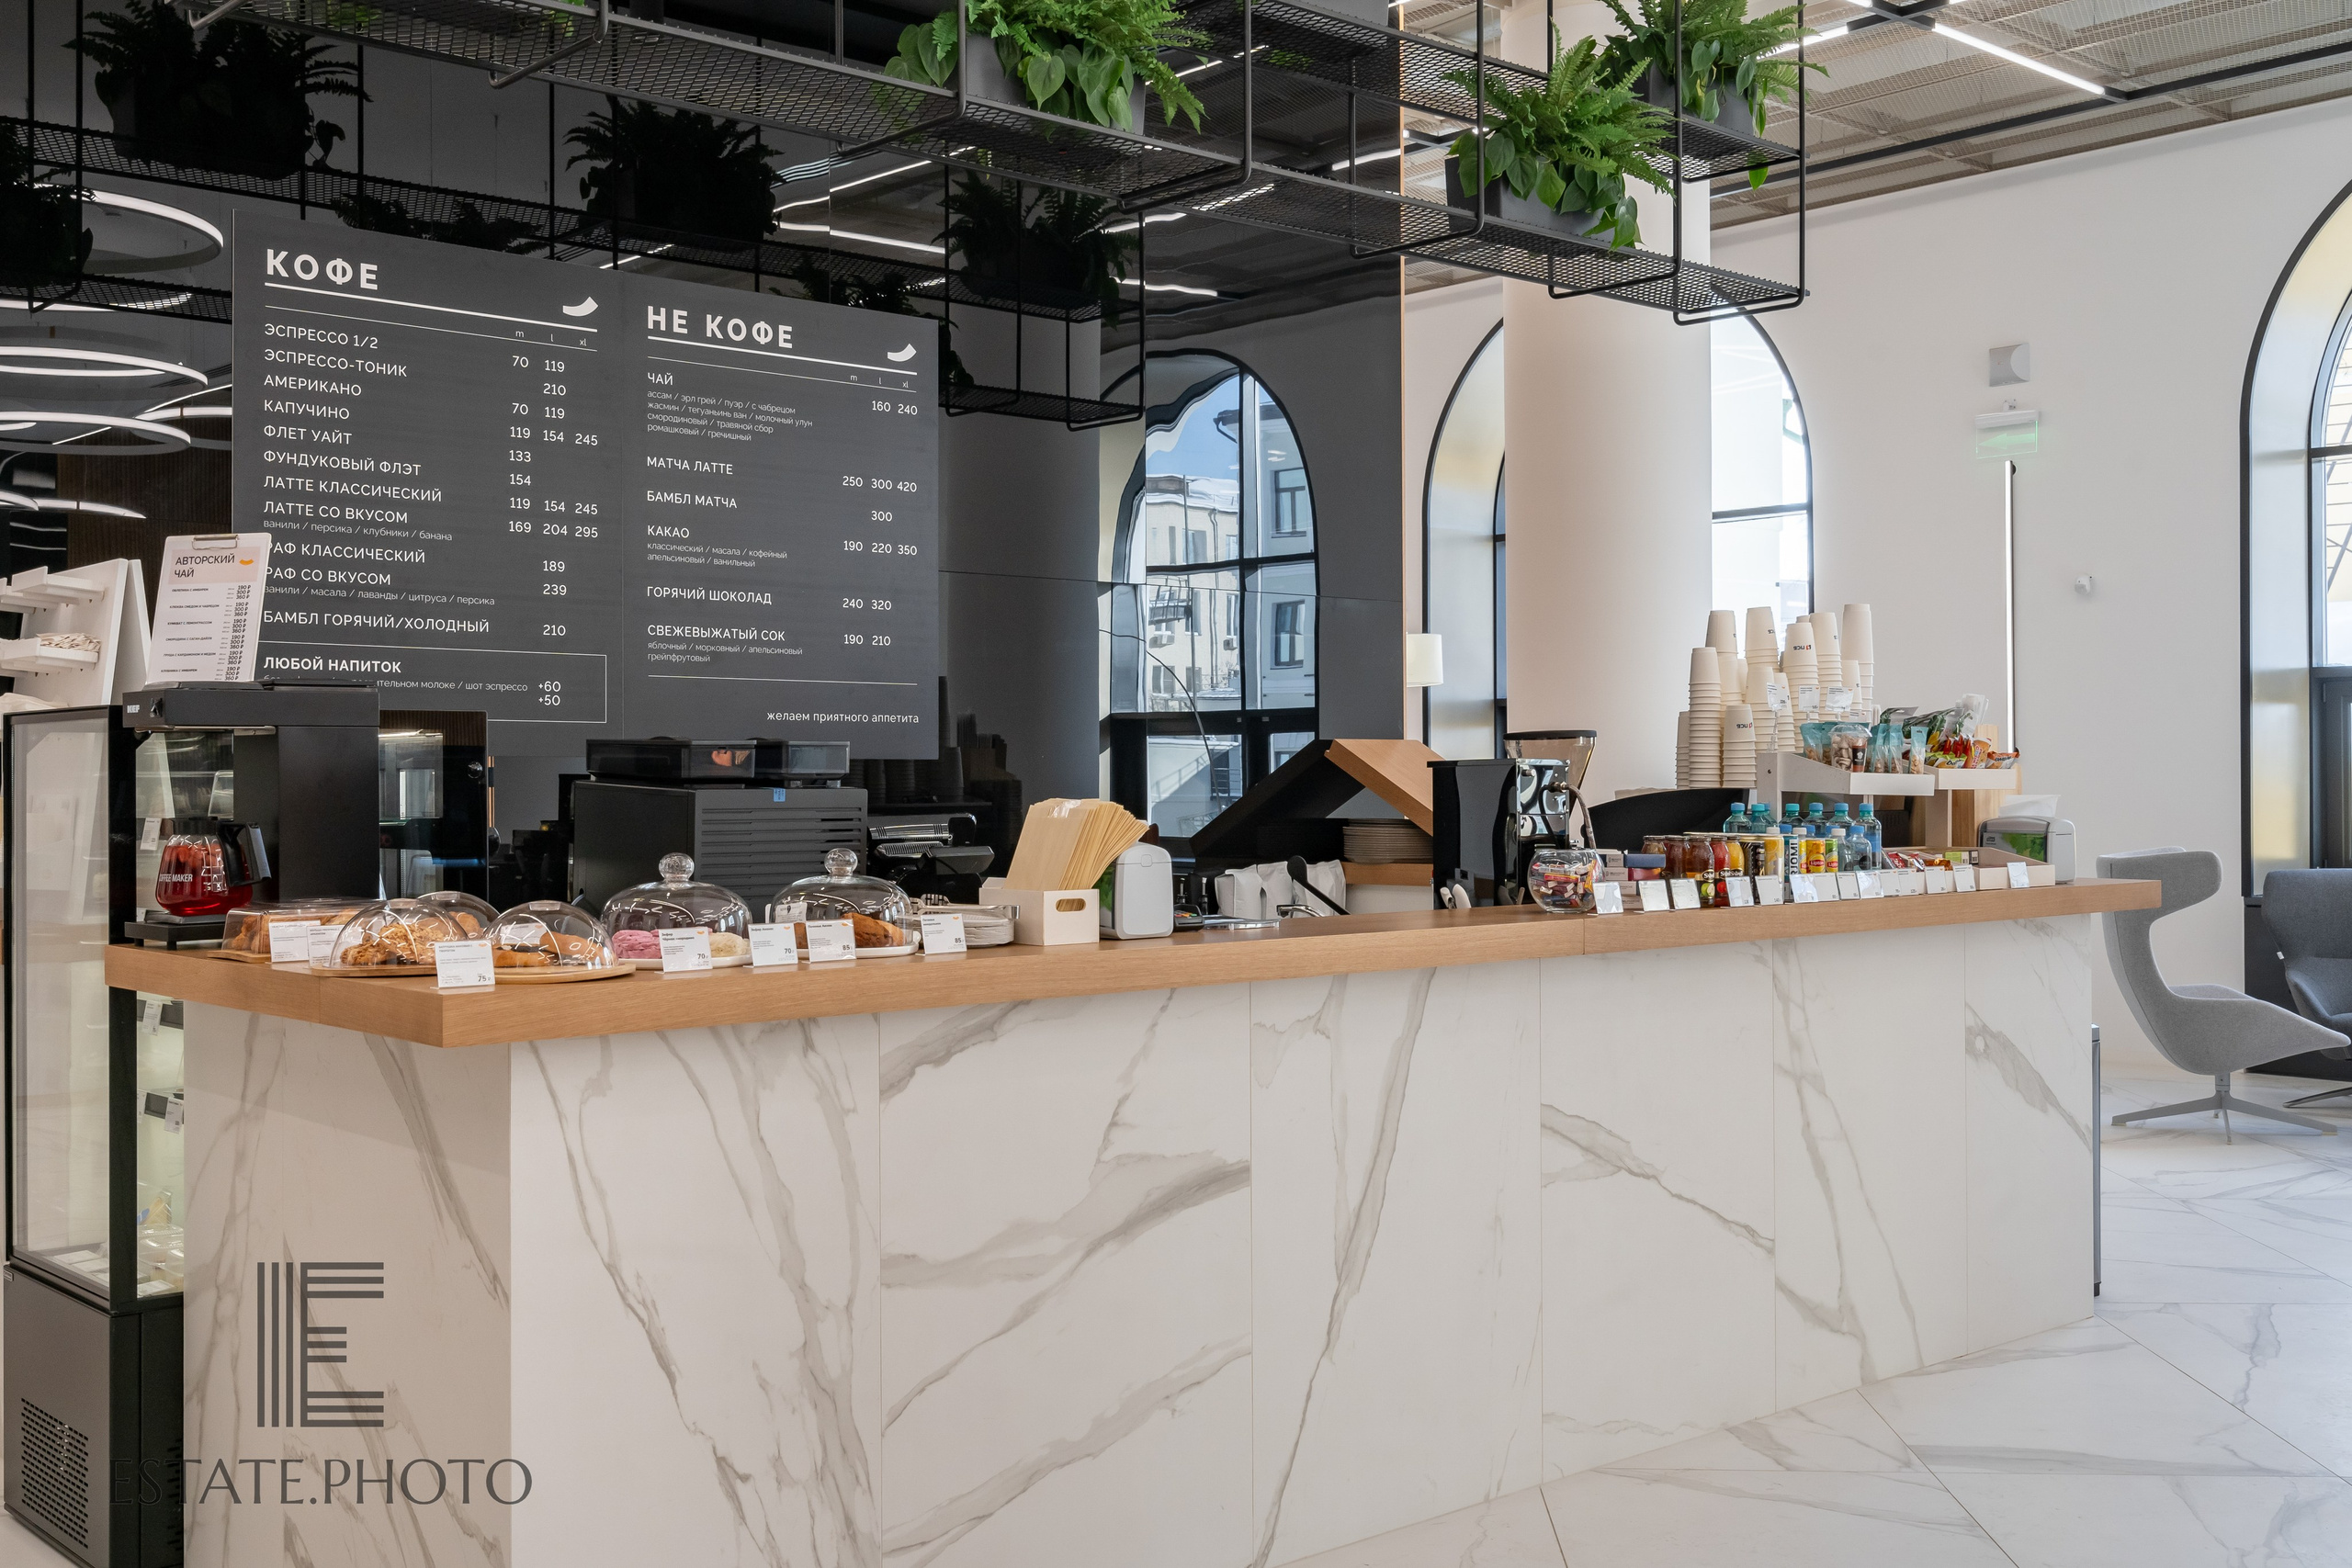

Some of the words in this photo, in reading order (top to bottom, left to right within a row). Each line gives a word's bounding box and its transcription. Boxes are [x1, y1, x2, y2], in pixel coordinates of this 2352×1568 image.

[267, 249, 378, 290] КОФЕ
[648, 306, 687, 333] НЕ
[707, 314, 792, 348] КОФЕ
[265, 323, 348, 344] ЭСПРЕССО
[354, 335, 378, 349] 1/2
[265, 349, 407, 377] ЭСПРЕССО-ТОНИК
[513, 355, 528, 367] 70
[545, 360, 564, 372] 119
[264, 375, 361, 396] АМЕРИКАНО
[648, 372, 673, 385] ЧАЙ
[544, 383, 566, 396] 210
[265, 400, 349, 419] КАПУЧИНО
[513, 403, 528, 414] 70
[545, 407, 564, 419] 119
[681, 395, 695, 403] эрл
[697, 397, 716, 405] грей
[725, 400, 743, 409] пуэр
[758, 404, 795, 413] чабрецом
[872, 400, 890, 412] 160
[898, 404, 918, 415] 240
[648, 402, 679, 411] жасмин
[755, 415, 793, 424] молочный
[795, 420, 812, 428] улун
[648, 413, 707, 425] смородиновый
[717, 421, 752, 430] травяной
[754, 424, 774, 434] сбор
[264, 425, 307, 440] ФЛЕТ
[311, 430, 352, 445] УАЙТ
[510, 426, 530, 438] 119
[543, 430, 564, 442] 154
[575, 434, 597, 446] 245
[648, 424, 698, 435] ромашковый
[708, 431, 751, 441] гречишный
[264, 450, 374, 471] ФУНДУКОВЫЙ
[379, 461, 421, 475] ФЛЭТ
[509, 450, 531, 462] 133
[648, 457, 690, 470] МАТЧА
[694, 461, 733, 474] ЛАТТЕ
[510, 474, 531, 486] 154
[842, 476, 863, 487] 250
[872, 479, 892, 490] 300
[897, 481, 917, 492] 420
[264, 476, 313, 491] ЛАТТЕ
[320, 480, 441, 502] КЛАССИЧЕСКИЙ
[510, 497, 530, 509] 119
[545, 501, 565, 512] 154
[575, 503, 597, 514] 245
[648, 491, 690, 504] БАМБЛ
[695, 495, 737, 508] МАТЧА
[264, 502, 313, 516] ЛАТТЕ
[319, 506, 340, 518] СО
[345, 508, 407, 523] ВКУСОМ
[871, 511, 892, 522] 300
[264, 521, 300, 529] ванили
[311, 525, 352, 534] персика
[364, 527, 408, 537] клубники
[420, 530, 452, 540] банана
[509, 521, 531, 533] 169
[543, 524, 568, 536] 204
[575, 526, 598, 537] 295
[648, 525, 689, 538] КАКАО
[269, 542, 297, 556] АФ
[302, 544, 424, 563] КЛАССИЧЕСКИЙ
[648, 544, 703, 552] классический
[749, 549, 786, 558] кофейный
[843, 540, 863, 551] 190
[872, 543, 892, 553] 220
[898, 545, 917, 555] 350
[175, 553, 235, 565] АВТОРСКИЙ
[543, 560, 565, 572] 189
[648, 554, 705, 563] апельсиновый
[714, 558, 755, 567] ванильный
[175, 568, 195, 578] ЧАЙ
[301, 569, 322, 581] СО
[328, 570, 390, 585] ВКУСОМ
[311, 589, 346, 597] масала
[357, 592, 398, 600] лаванды
[409, 594, 447, 604] цитруса
[458, 597, 494, 605] персика
[543, 584, 567, 595] 239
[648, 586, 705, 600] ГОРЯЧИЙ
[709, 590, 772, 605] ШОКОЛАД
[842, 598, 863, 608] 240
[872, 600, 891, 610] 320
[265, 611, 318, 625] БАМБЛ
[324, 614, 489, 633] ГОРЯЧИЙ/ХОЛОДНЫЙ
[543, 625, 566, 636] 210
[648, 625, 757, 639] СВЕЖЕВЫЖАТЫЙ
[762, 630, 785, 641] СОК
[648, 641, 686, 649] яблочный
[844, 634, 863, 644] 190
[872, 636, 890, 646] 210
[264, 656, 322, 671] ЛЮБОЙ
[329, 660, 401, 672] НАПИТОК
[648, 653, 710, 663] грейпфрутовый
[485, 683, 527, 692] эспрессо
[538, 681, 560, 692] +60
[538, 694, 560, 705] +50
[767, 713, 809, 721] желаем
[814, 714, 868, 724] приятного
[872, 715, 919, 723] аппетита
[172, 874, 193, 882] MAKER
